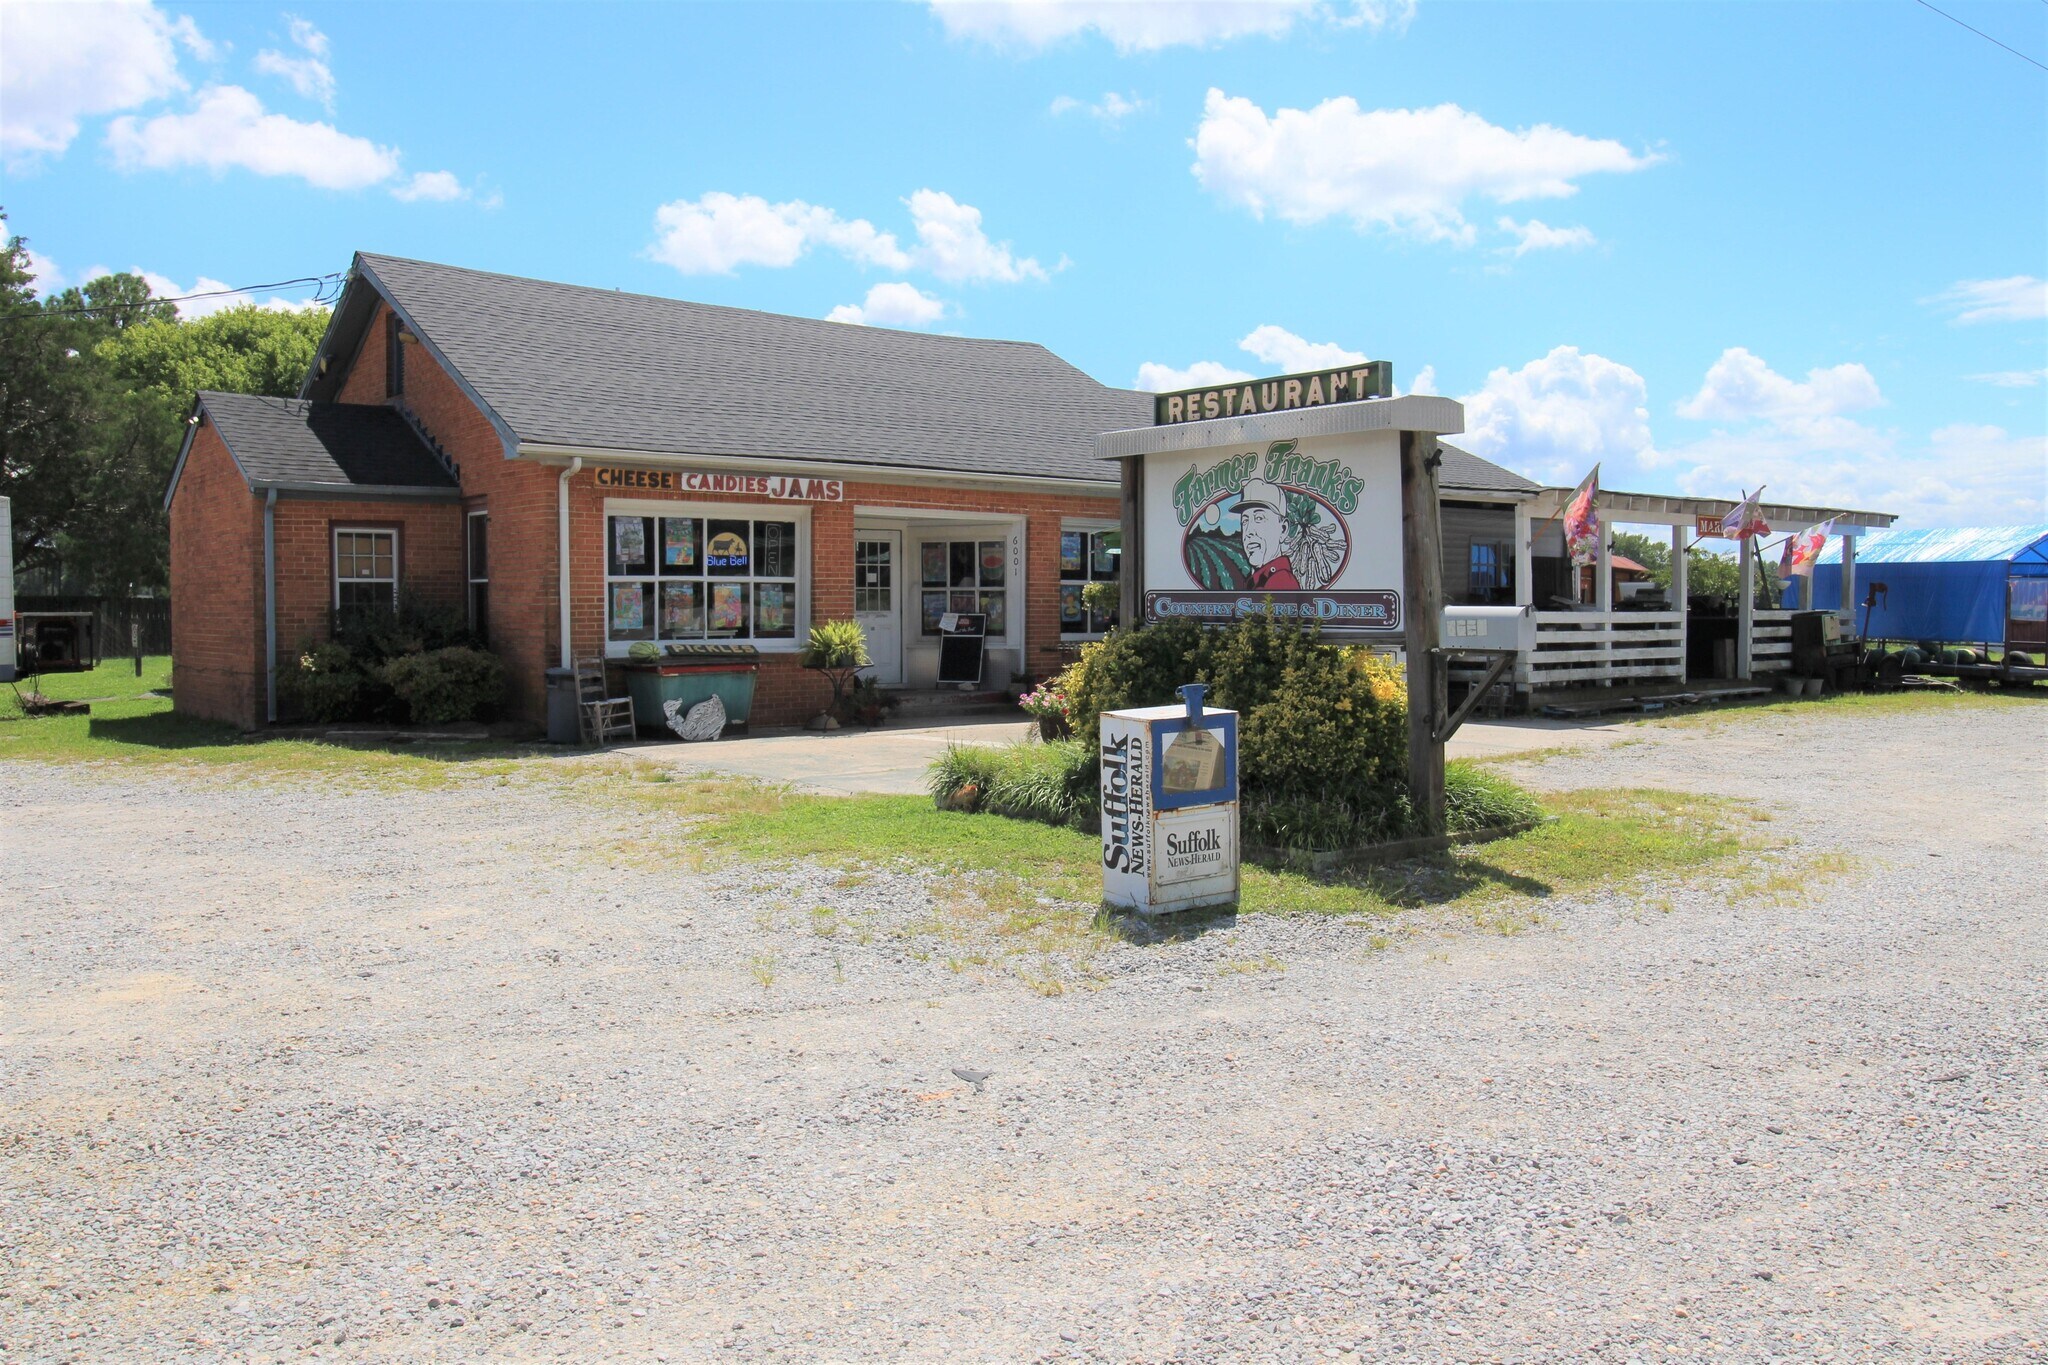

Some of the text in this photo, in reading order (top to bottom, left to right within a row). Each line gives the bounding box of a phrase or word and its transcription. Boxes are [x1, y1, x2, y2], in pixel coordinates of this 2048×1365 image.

[1168, 368, 1369, 424] RESTAURANT
[597, 468, 672, 489] CHEESE
[686, 473, 768, 493] CANDIES
[771, 478, 841, 501] JAMS
[1173, 438, 1365, 527] Farmer Frank's
[706, 553, 748, 567] Blue Bell
[768, 527, 779, 575] OPEN
[1154, 597, 1234, 617] COUNTRY
[1299, 603, 1314, 617] &
[1313, 597, 1388, 619] DINER
[671, 644, 755, 653] PICKLES
[1102, 733, 1129, 874] Suffolk
[1129, 737, 1145, 877] NEWS-HERALD
[1167, 828, 1221, 856] Suffolk
[1168, 852, 1221, 869] NEWS-HERALD
